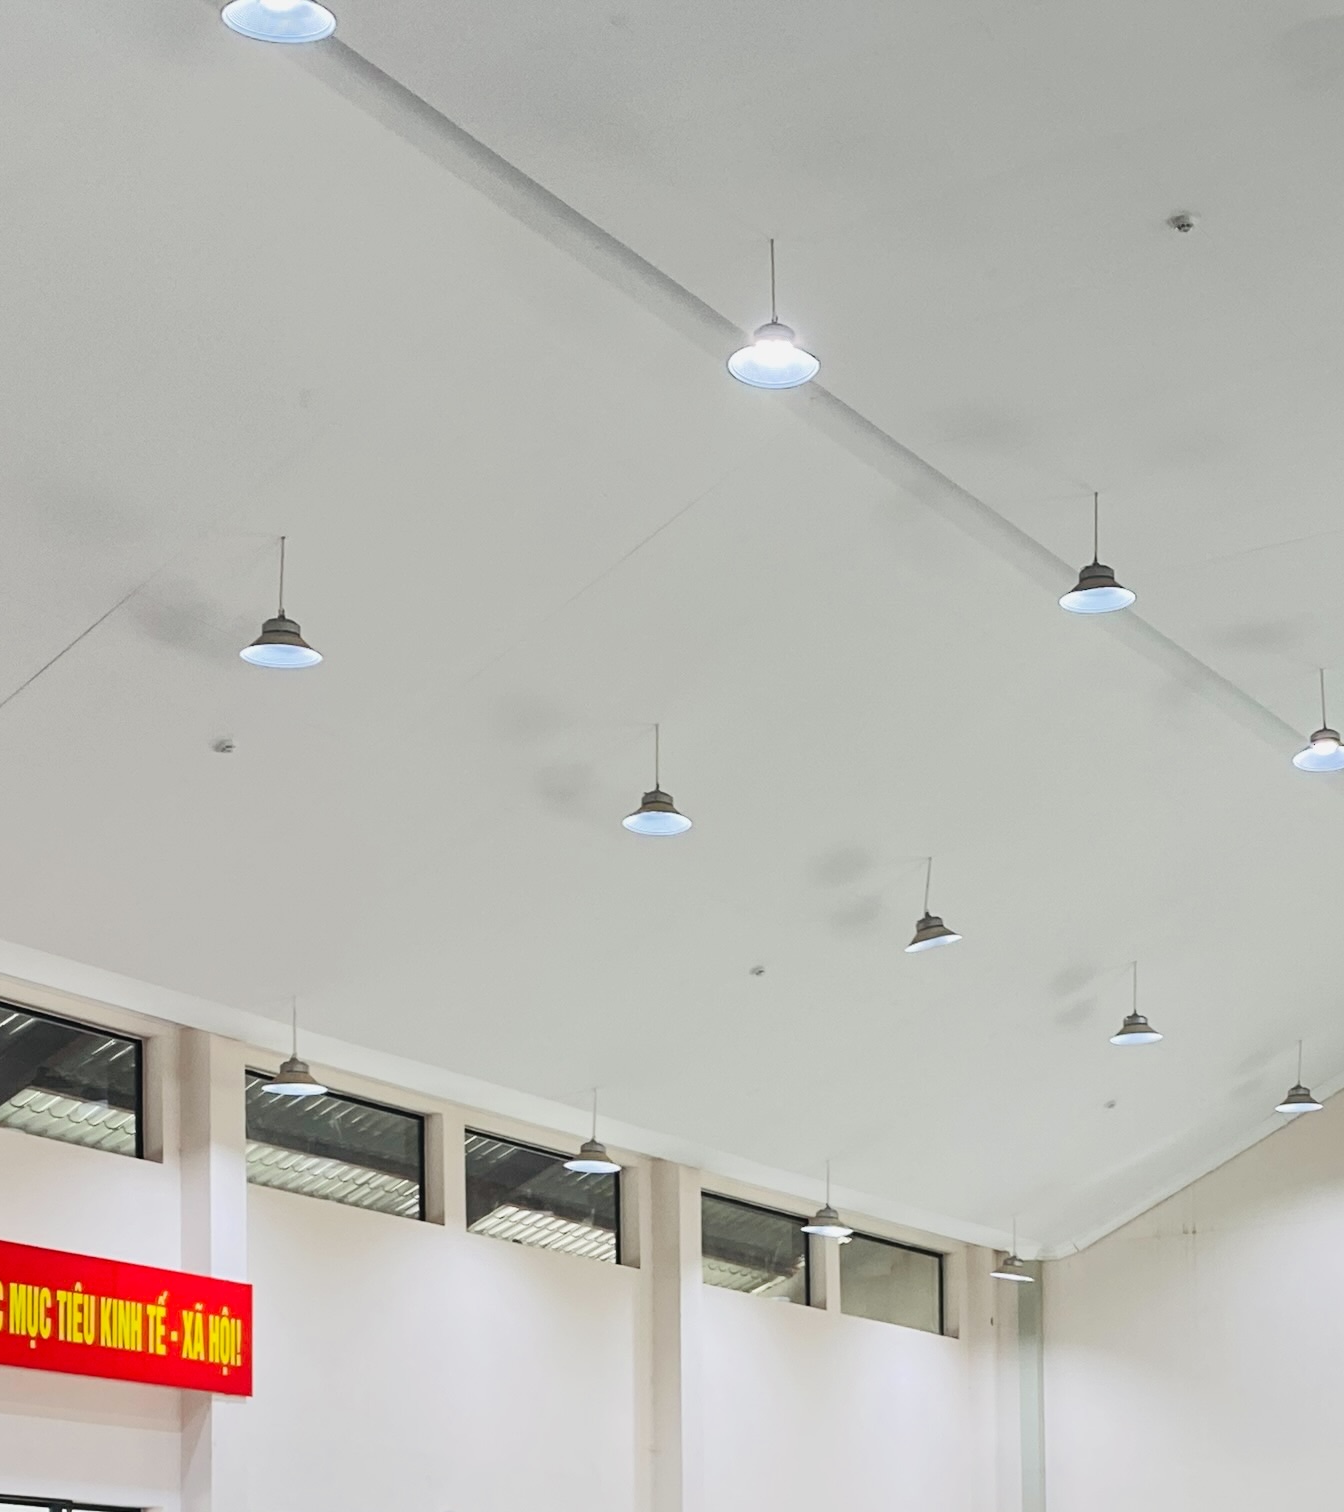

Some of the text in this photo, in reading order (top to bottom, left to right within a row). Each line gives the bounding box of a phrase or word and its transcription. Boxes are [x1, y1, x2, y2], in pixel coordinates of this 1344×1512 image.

[8, 1282, 52, 1349] MỤC
[56, 1281, 97, 1346] TIÊU
[99, 1296, 144, 1352] KINH
[145, 1290, 169, 1356] TẾ
[181, 1302, 206, 1362] XÃ
[208, 1301, 242, 1376] HỘI!
